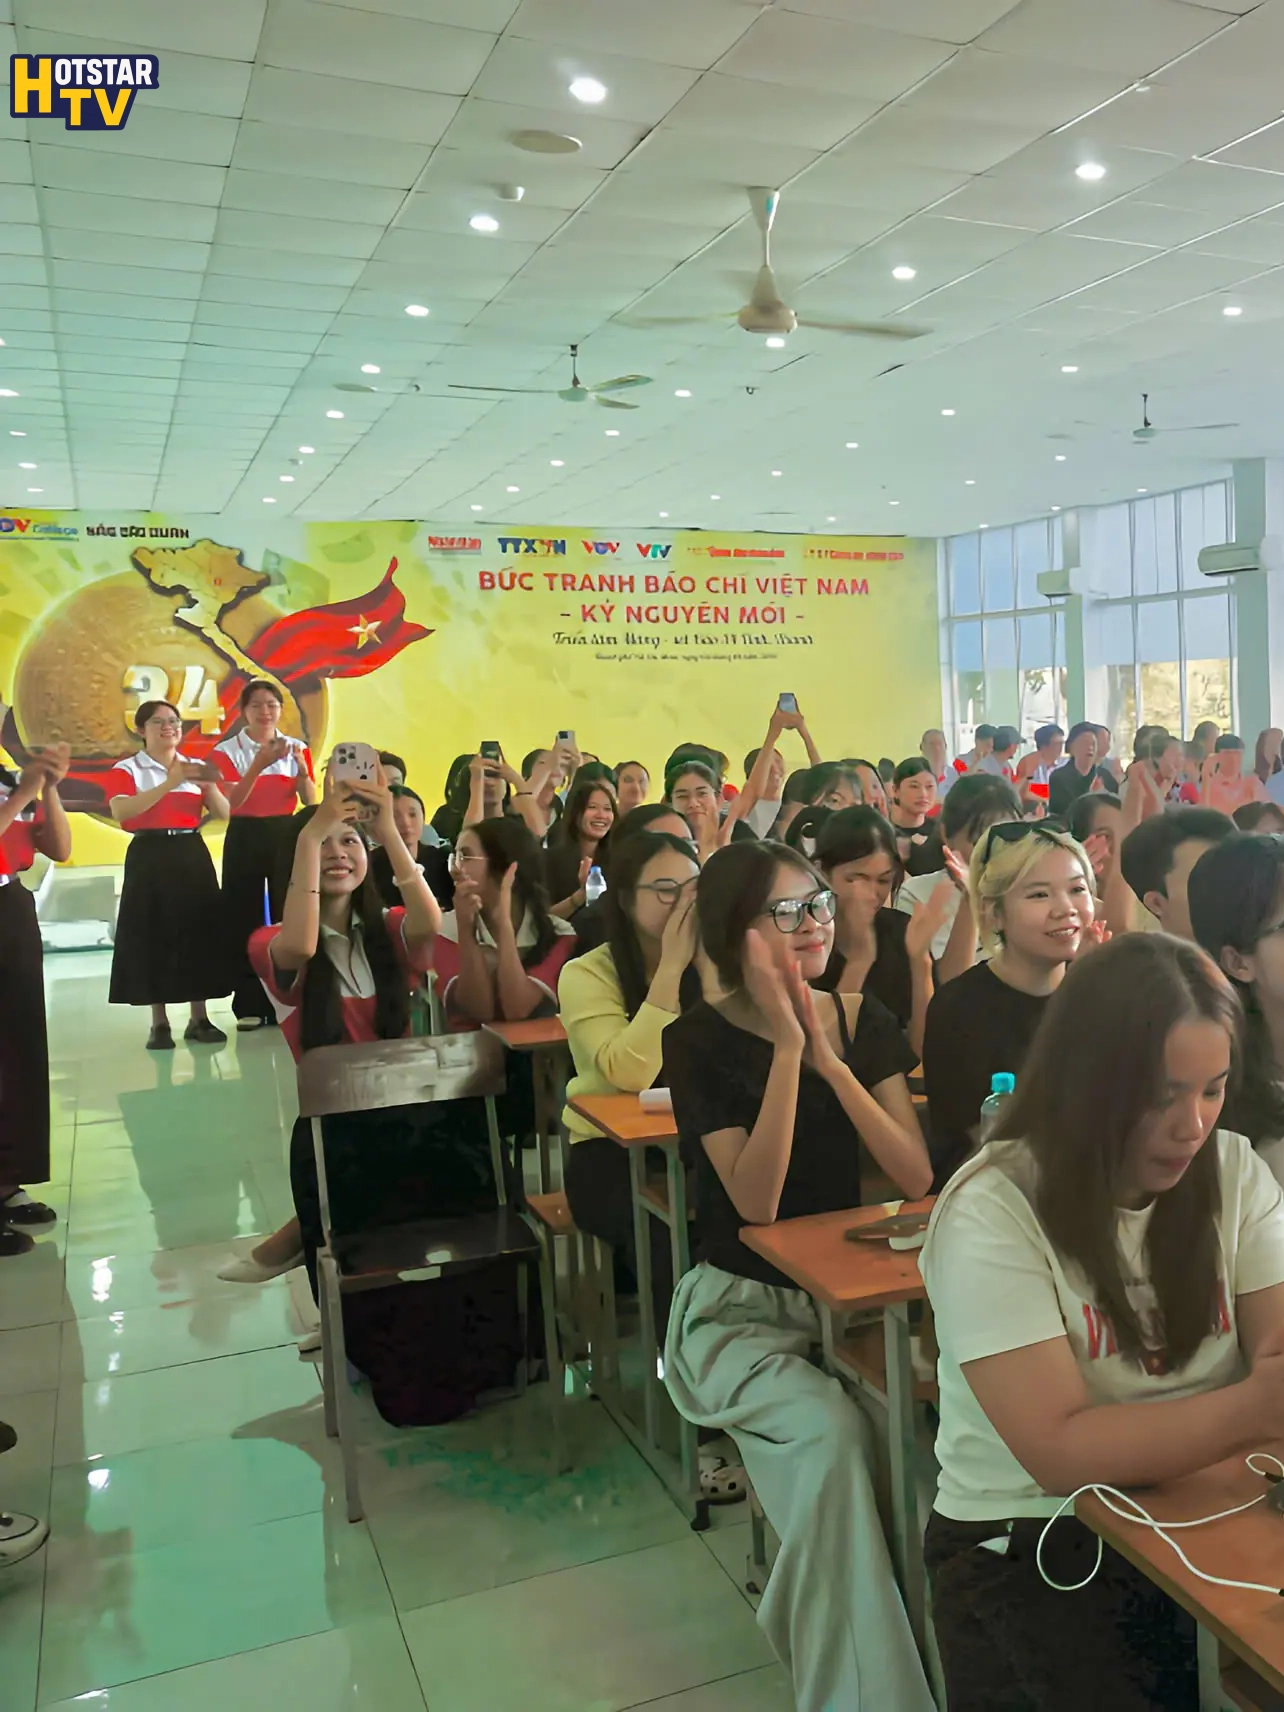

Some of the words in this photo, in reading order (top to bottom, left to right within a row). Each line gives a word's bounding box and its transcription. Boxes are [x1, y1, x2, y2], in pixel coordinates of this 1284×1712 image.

[636, 543, 672, 559] VTV
[543, 572, 635, 593] TRANH
[644, 570, 696, 594] BÁO
[817, 578, 869, 595] NAM
[626, 601, 729, 624] NGUYÊN
